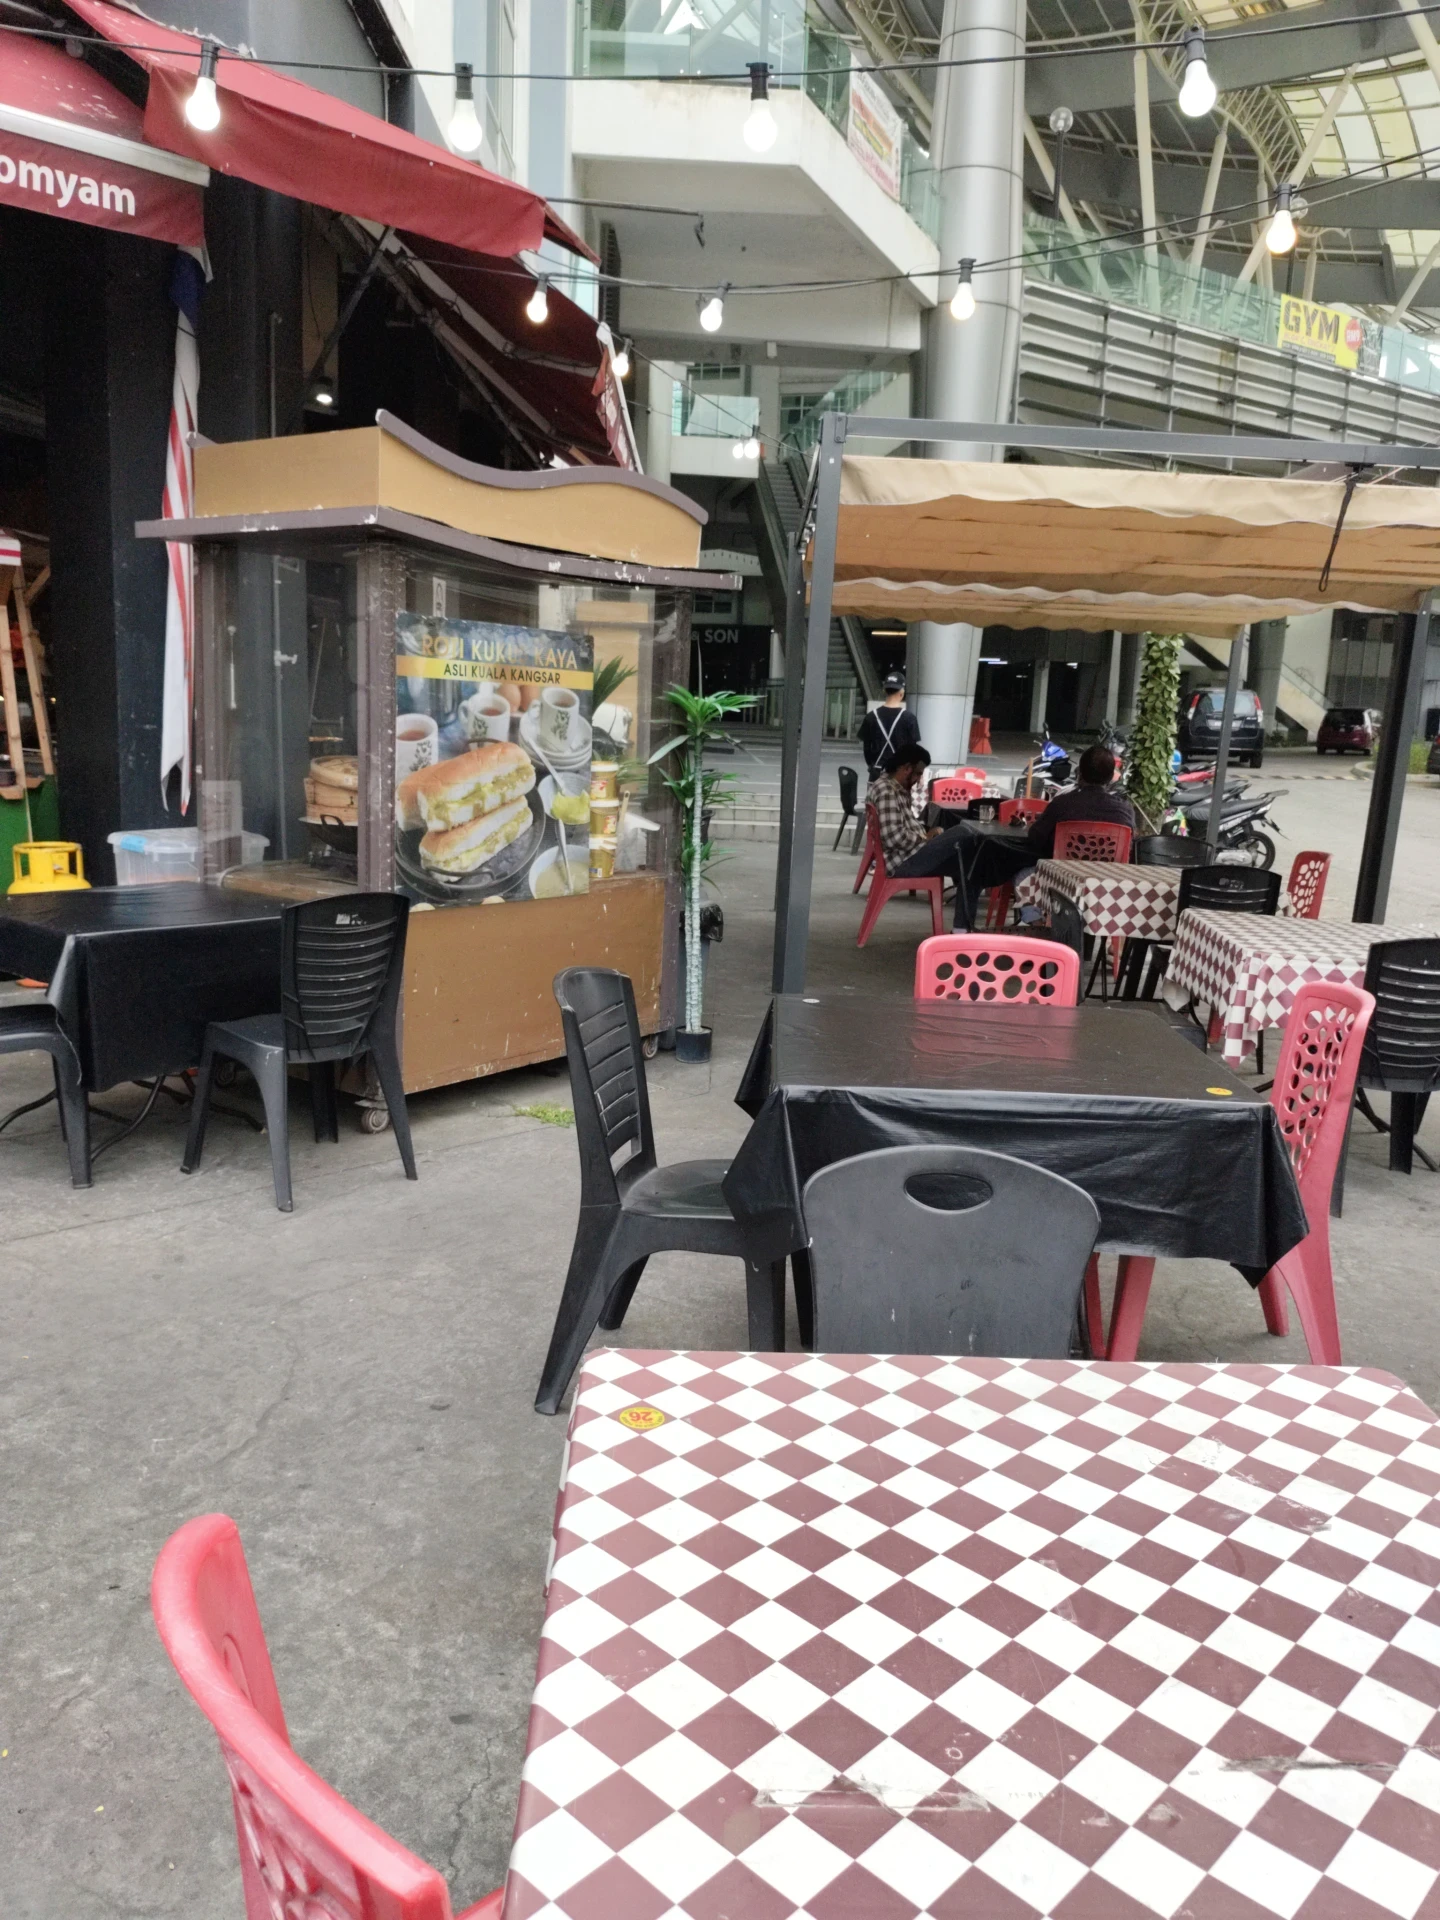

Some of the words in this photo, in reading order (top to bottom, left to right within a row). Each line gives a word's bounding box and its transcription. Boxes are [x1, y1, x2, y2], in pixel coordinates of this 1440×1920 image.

[0, 154, 136, 216] omyam
[1283, 301, 1341, 345] GYM
[422, 635, 465, 660] ROTI
[535, 647, 578, 670] KAYA
[704, 628, 739, 643] SON
[444, 663, 467, 677] ASLI
[471, 664, 507, 681] KUALA
[510, 669, 561, 685] KANGSAR
